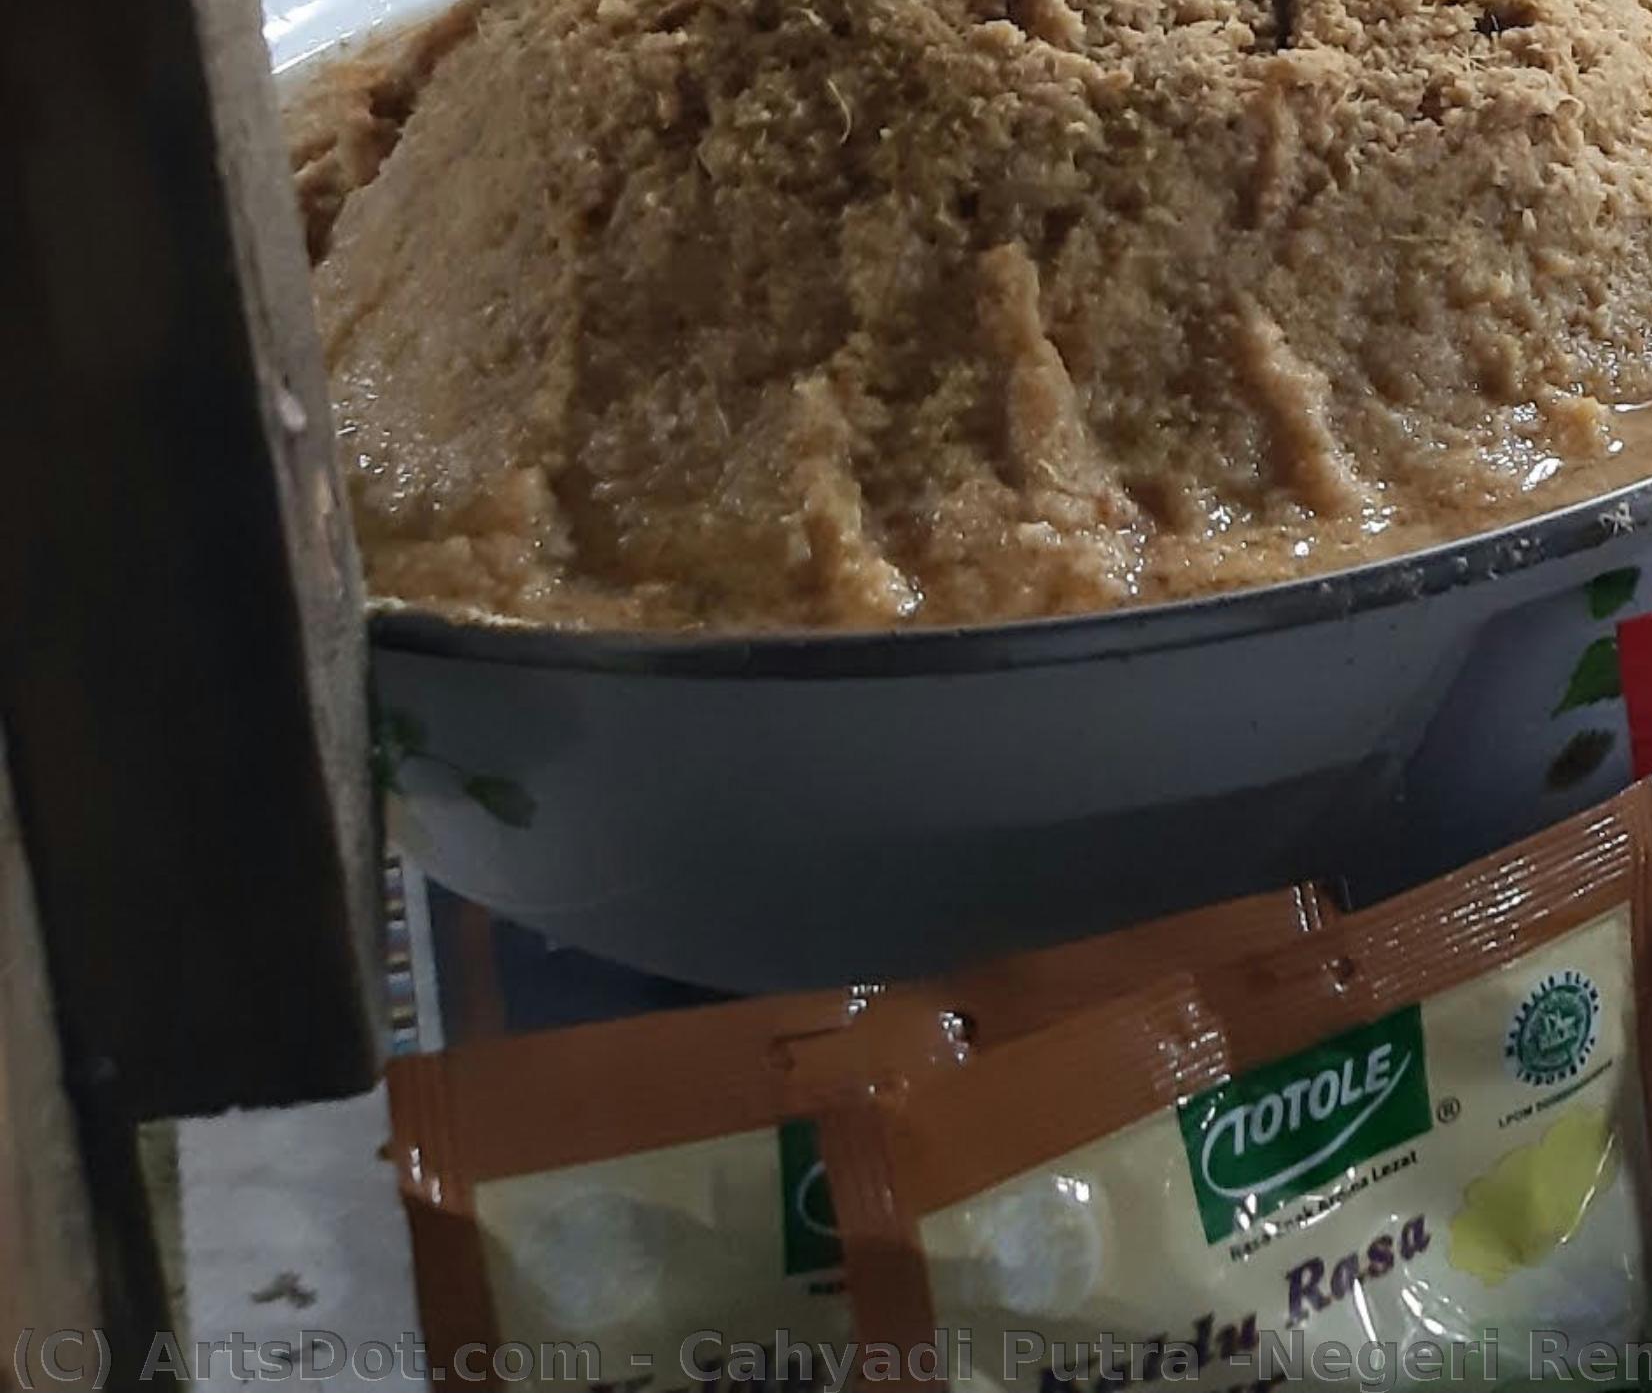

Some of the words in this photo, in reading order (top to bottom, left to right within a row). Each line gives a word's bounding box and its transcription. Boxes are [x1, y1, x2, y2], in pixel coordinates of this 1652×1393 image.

[1203, 1042, 1401, 1169] TOTOLE
[1371, 1150, 1417, 1183] Lezat
[1286, 1214, 1432, 1329] Rasa
